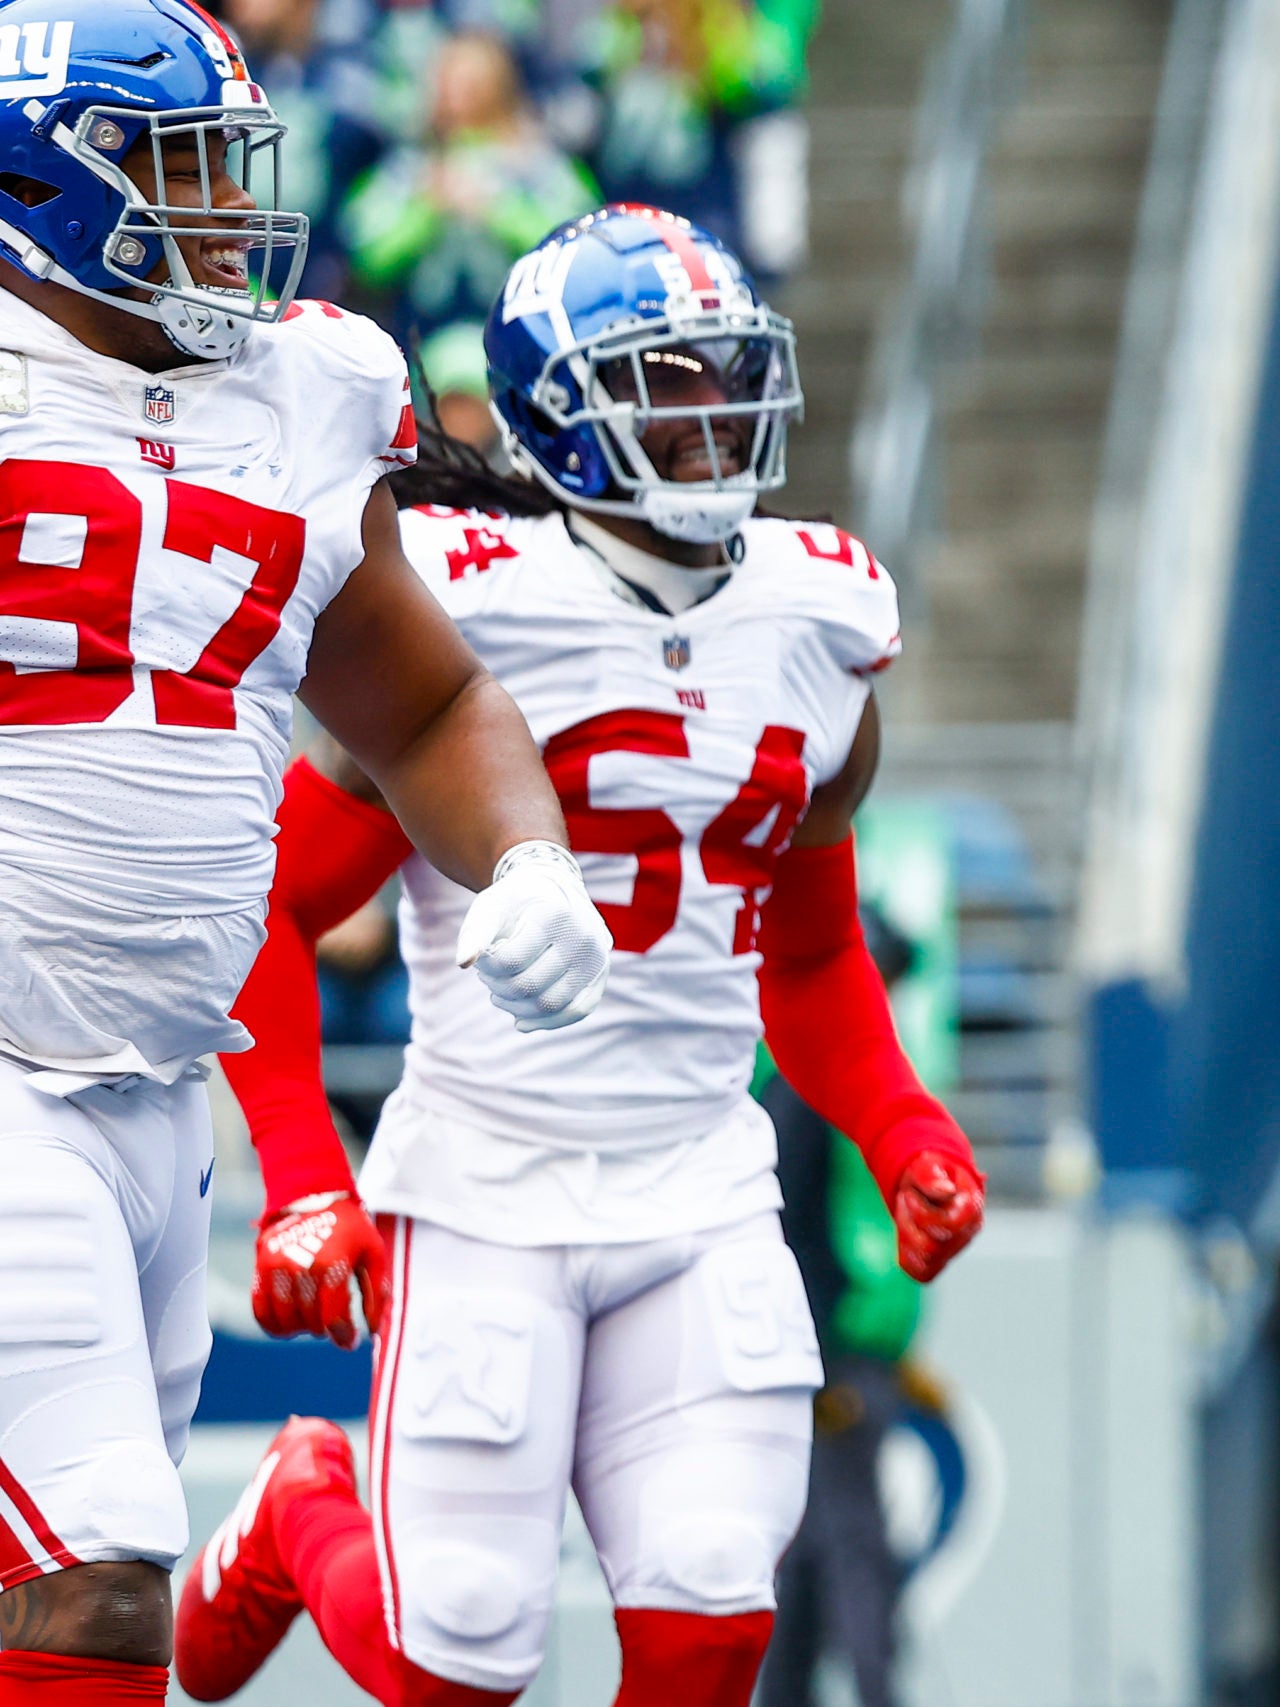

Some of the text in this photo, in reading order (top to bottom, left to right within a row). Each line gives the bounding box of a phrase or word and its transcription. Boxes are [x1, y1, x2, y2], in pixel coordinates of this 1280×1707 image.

[135, 437, 176, 471] ny
[147, 400, 172, 419] NFL
[0, 458, 306, 730] 97
[543, 708, 808, 957] 54
